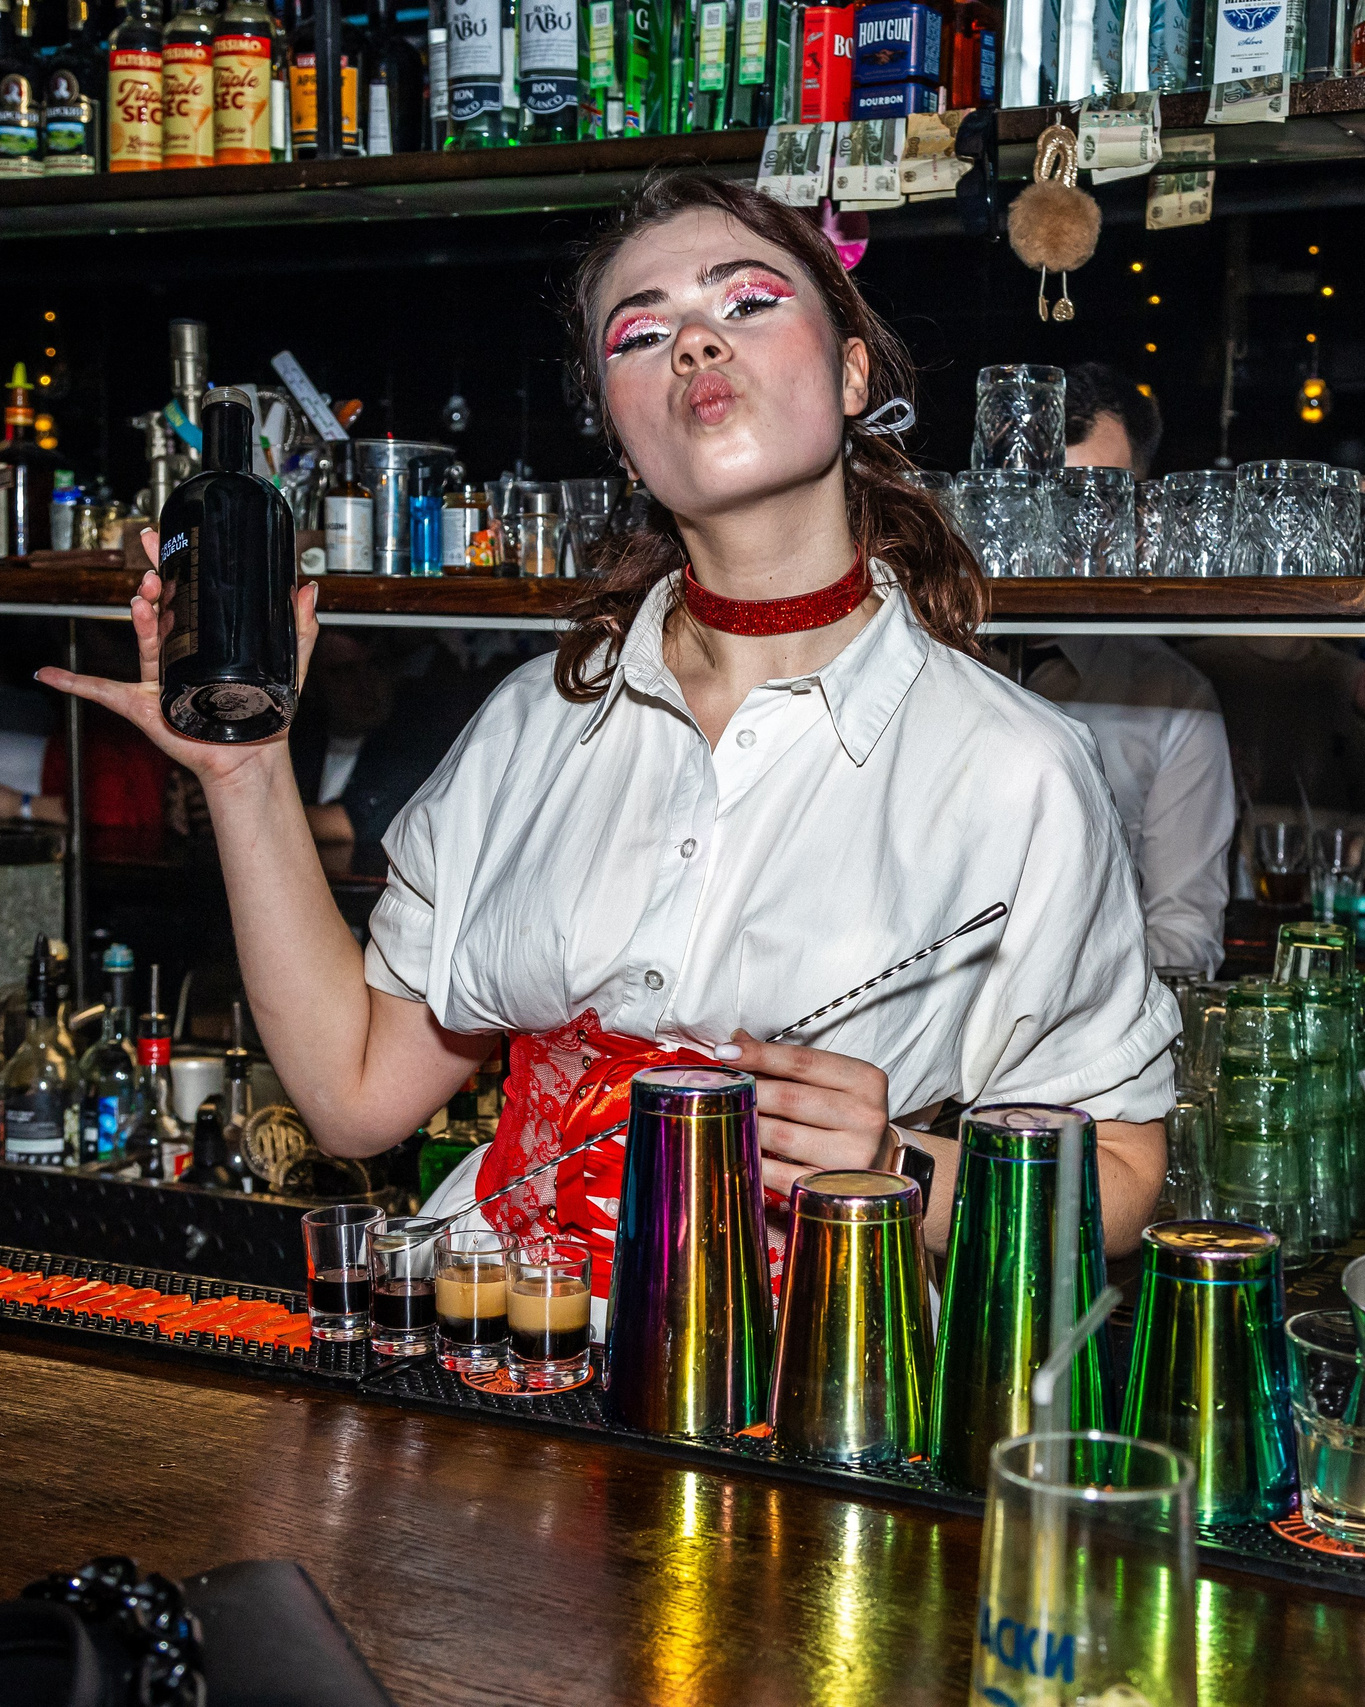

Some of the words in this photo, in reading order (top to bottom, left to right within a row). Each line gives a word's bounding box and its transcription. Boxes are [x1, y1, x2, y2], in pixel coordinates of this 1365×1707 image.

[533, 4, 554, 12] RON
[525, 11, 572, 34] TABÚ
[532, 82, 557, 94] RON
[860, 95, 903, 107] BOURBON
[840, 137, 853, 158] 10
[764, 150, 778, 169] 10
